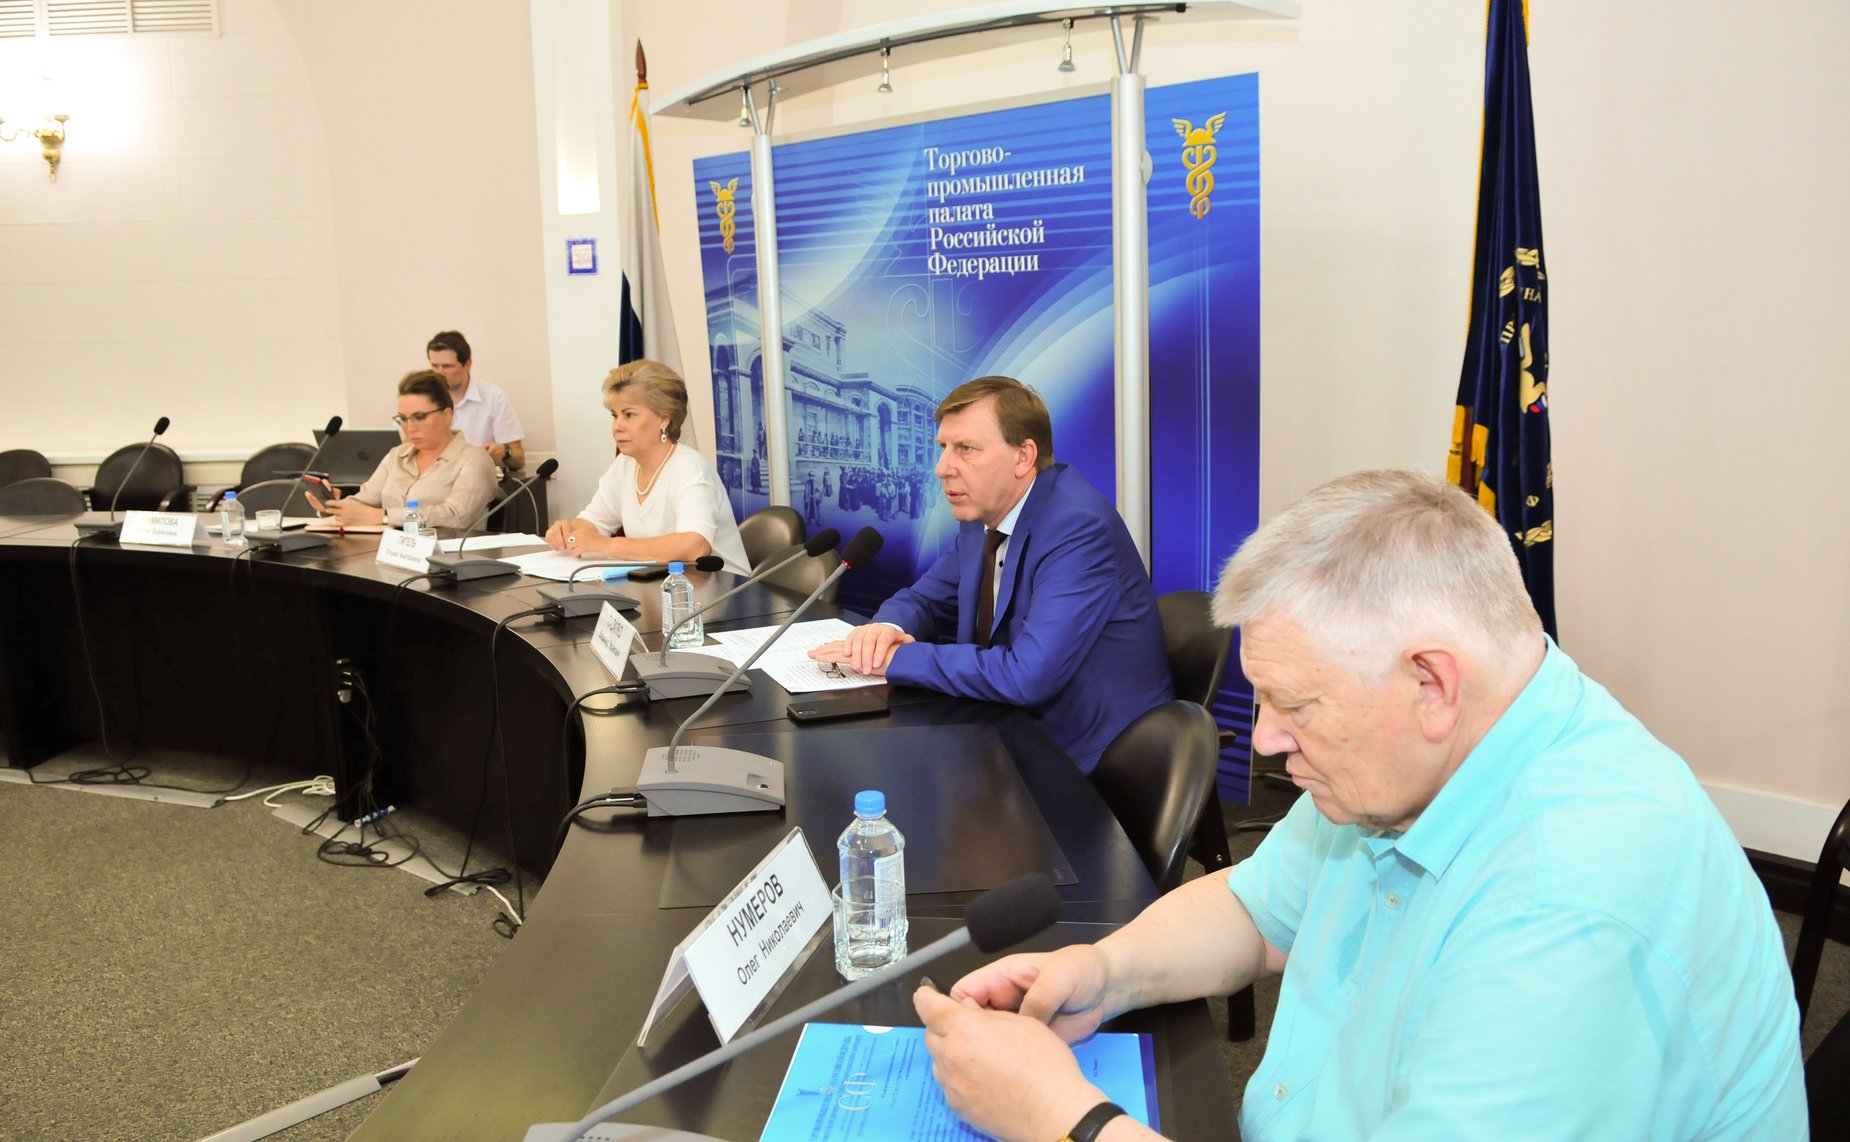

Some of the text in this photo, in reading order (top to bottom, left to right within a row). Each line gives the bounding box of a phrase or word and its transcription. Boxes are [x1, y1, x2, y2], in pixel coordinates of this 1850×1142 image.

[924, 146, 1012, 175] Торгово-
[927, 166, 1085, 203] промышленная
[928, 202, 994, 224] палата
[930, 219, 1045, 250] Российской
[928, 252, 1039, 280] Федерации
[727, 873, 784, 947] НУМЕРОВ
[737, 901, 805, 985] Олег Николаевич
